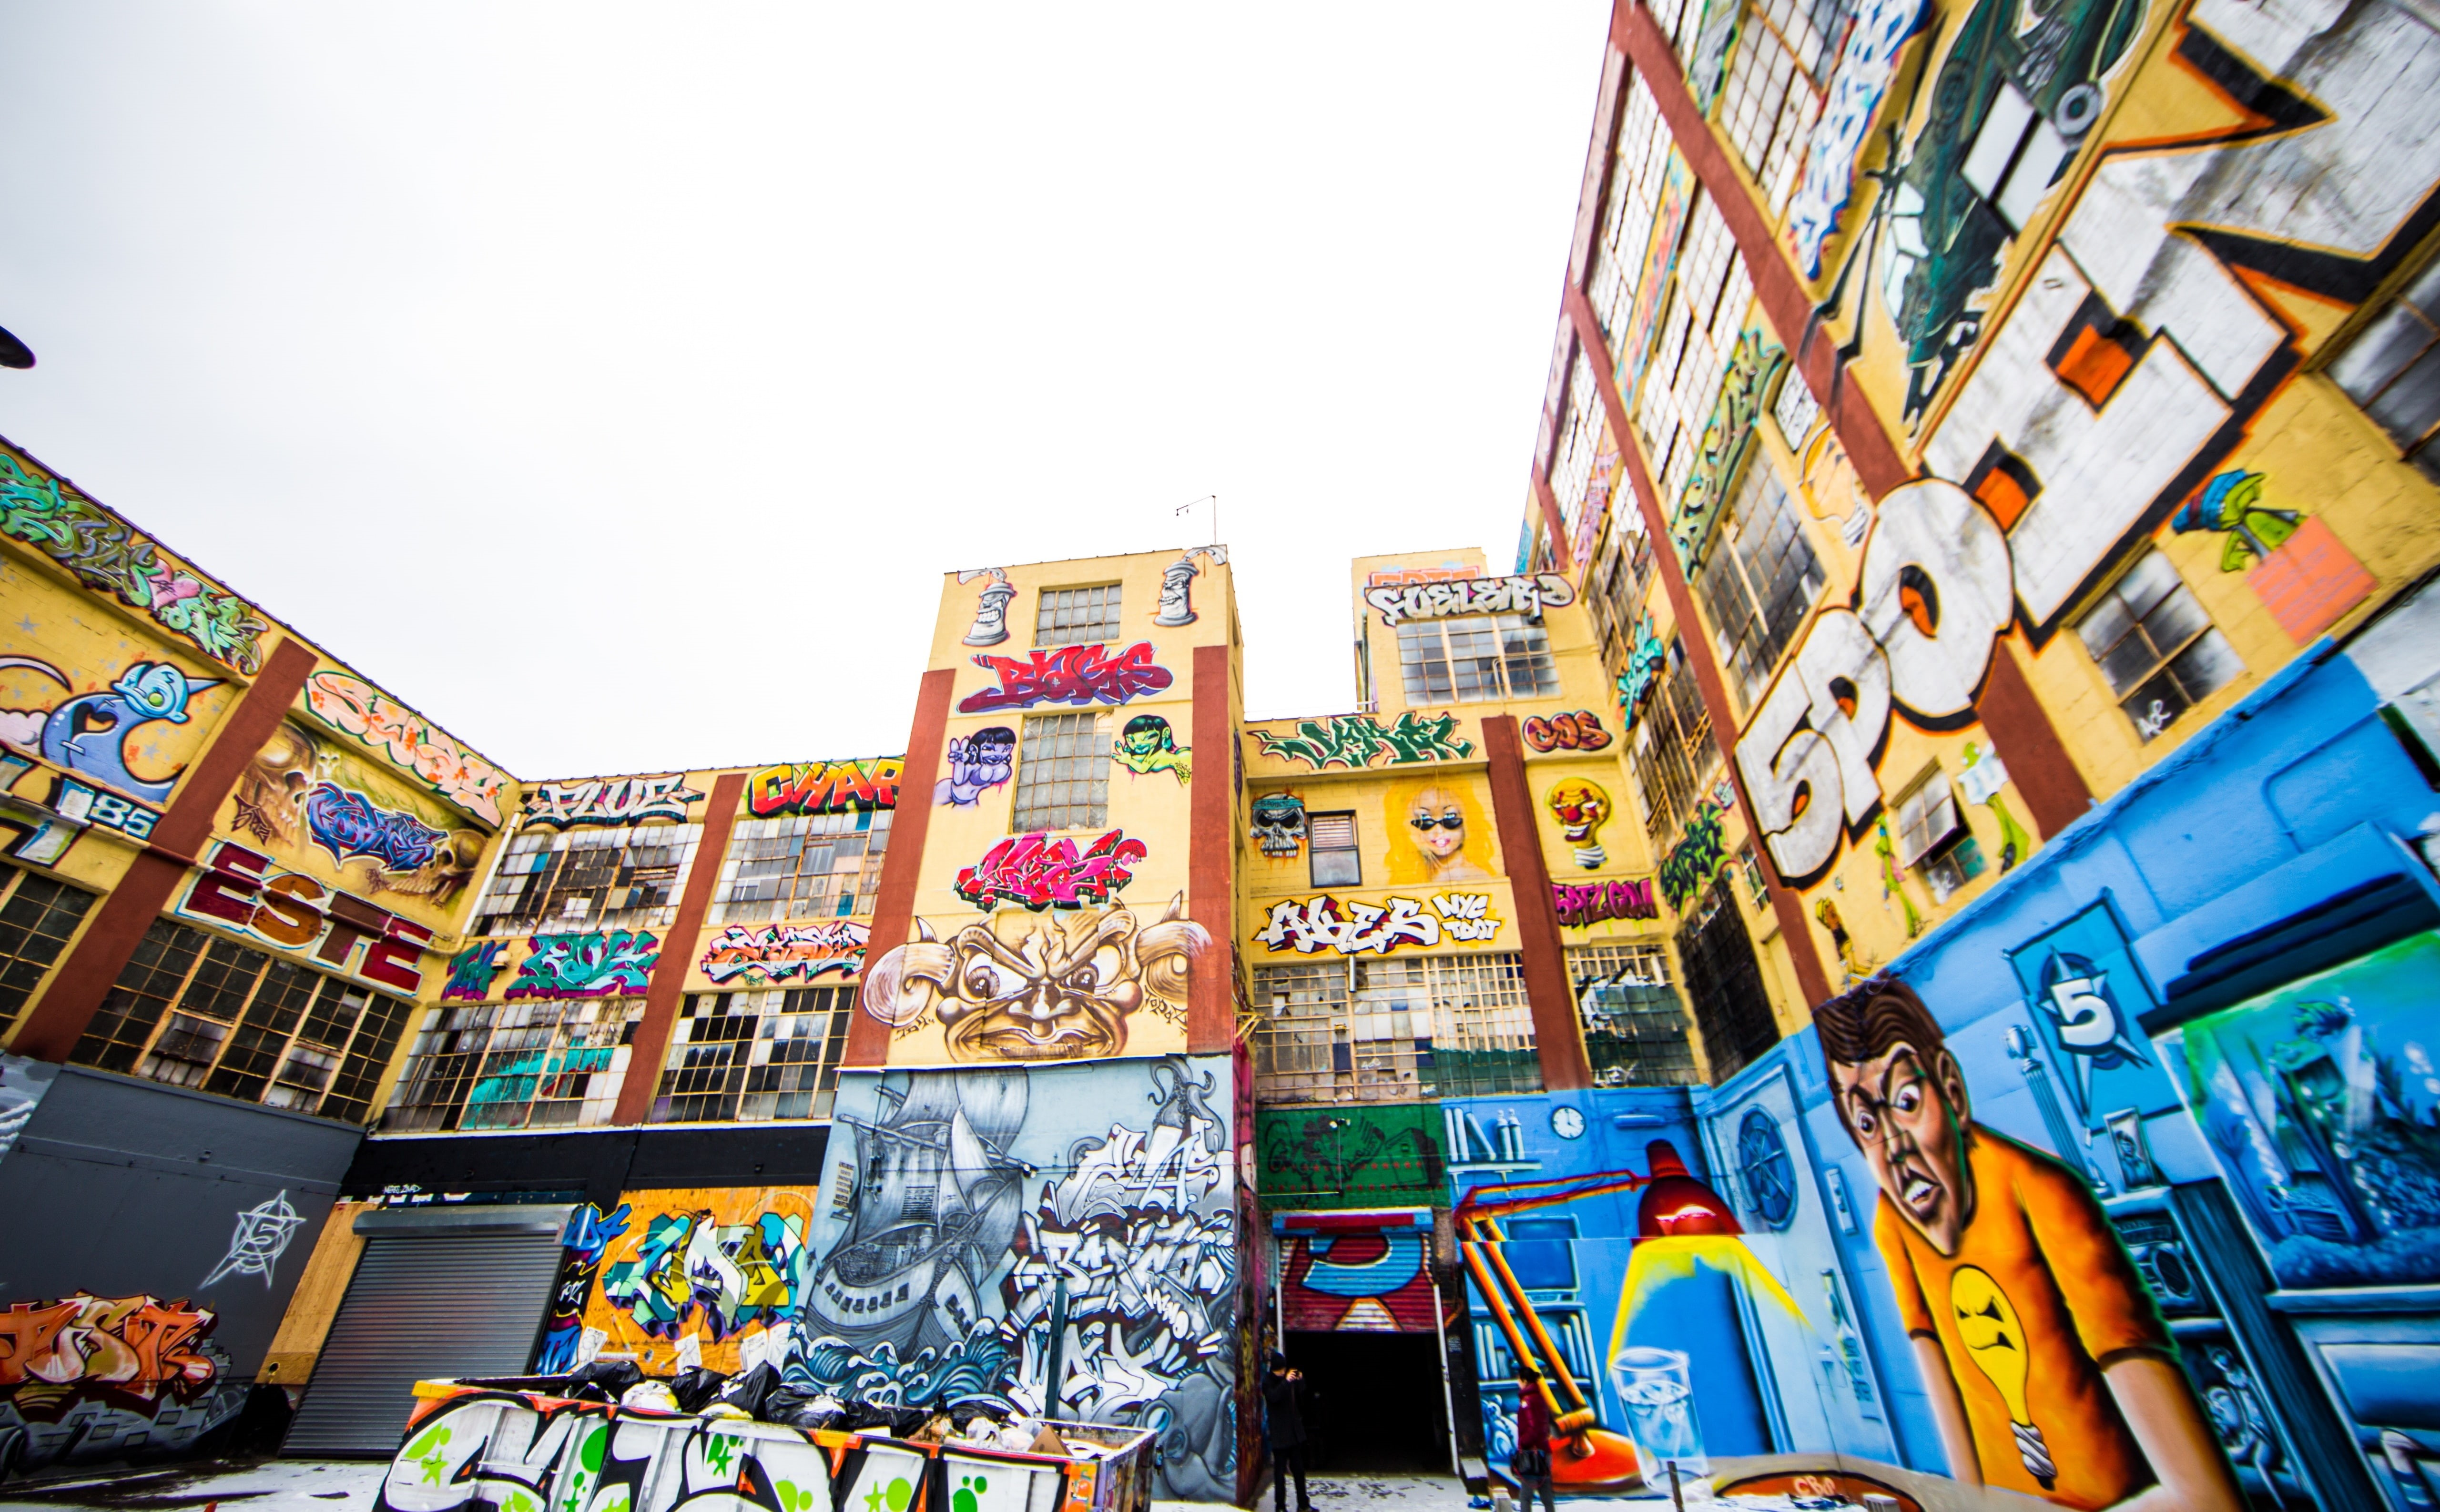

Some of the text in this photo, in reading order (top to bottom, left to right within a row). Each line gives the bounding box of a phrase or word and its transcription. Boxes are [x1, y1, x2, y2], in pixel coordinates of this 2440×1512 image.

[90, 791, 162, 841] 85
[1431, 893, 1489, 919] NYC
[1440, 918, 1501, 942] TDOT
[2059, 979, 2116, 1047] 5
